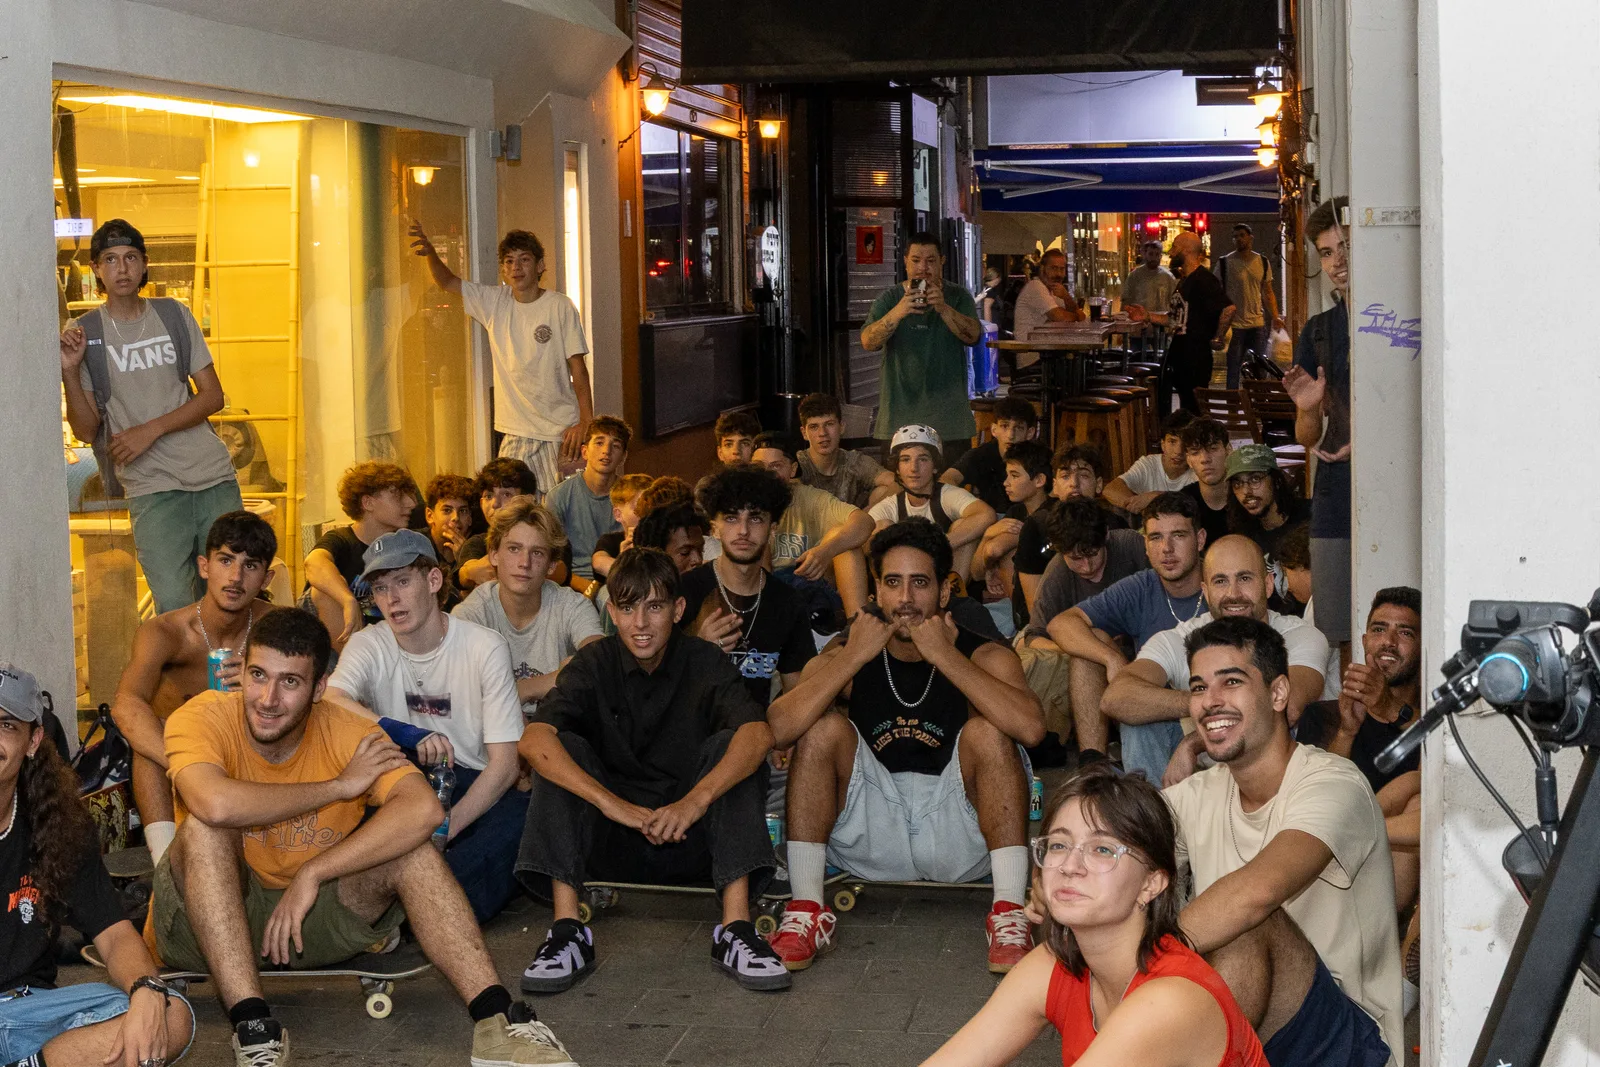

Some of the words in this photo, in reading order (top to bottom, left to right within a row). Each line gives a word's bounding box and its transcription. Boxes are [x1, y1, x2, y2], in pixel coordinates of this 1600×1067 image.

[106, 334, 177, 373] VANS
[0, 669, 19, 681] CAN
[873, 732, 893, 752] LIES
